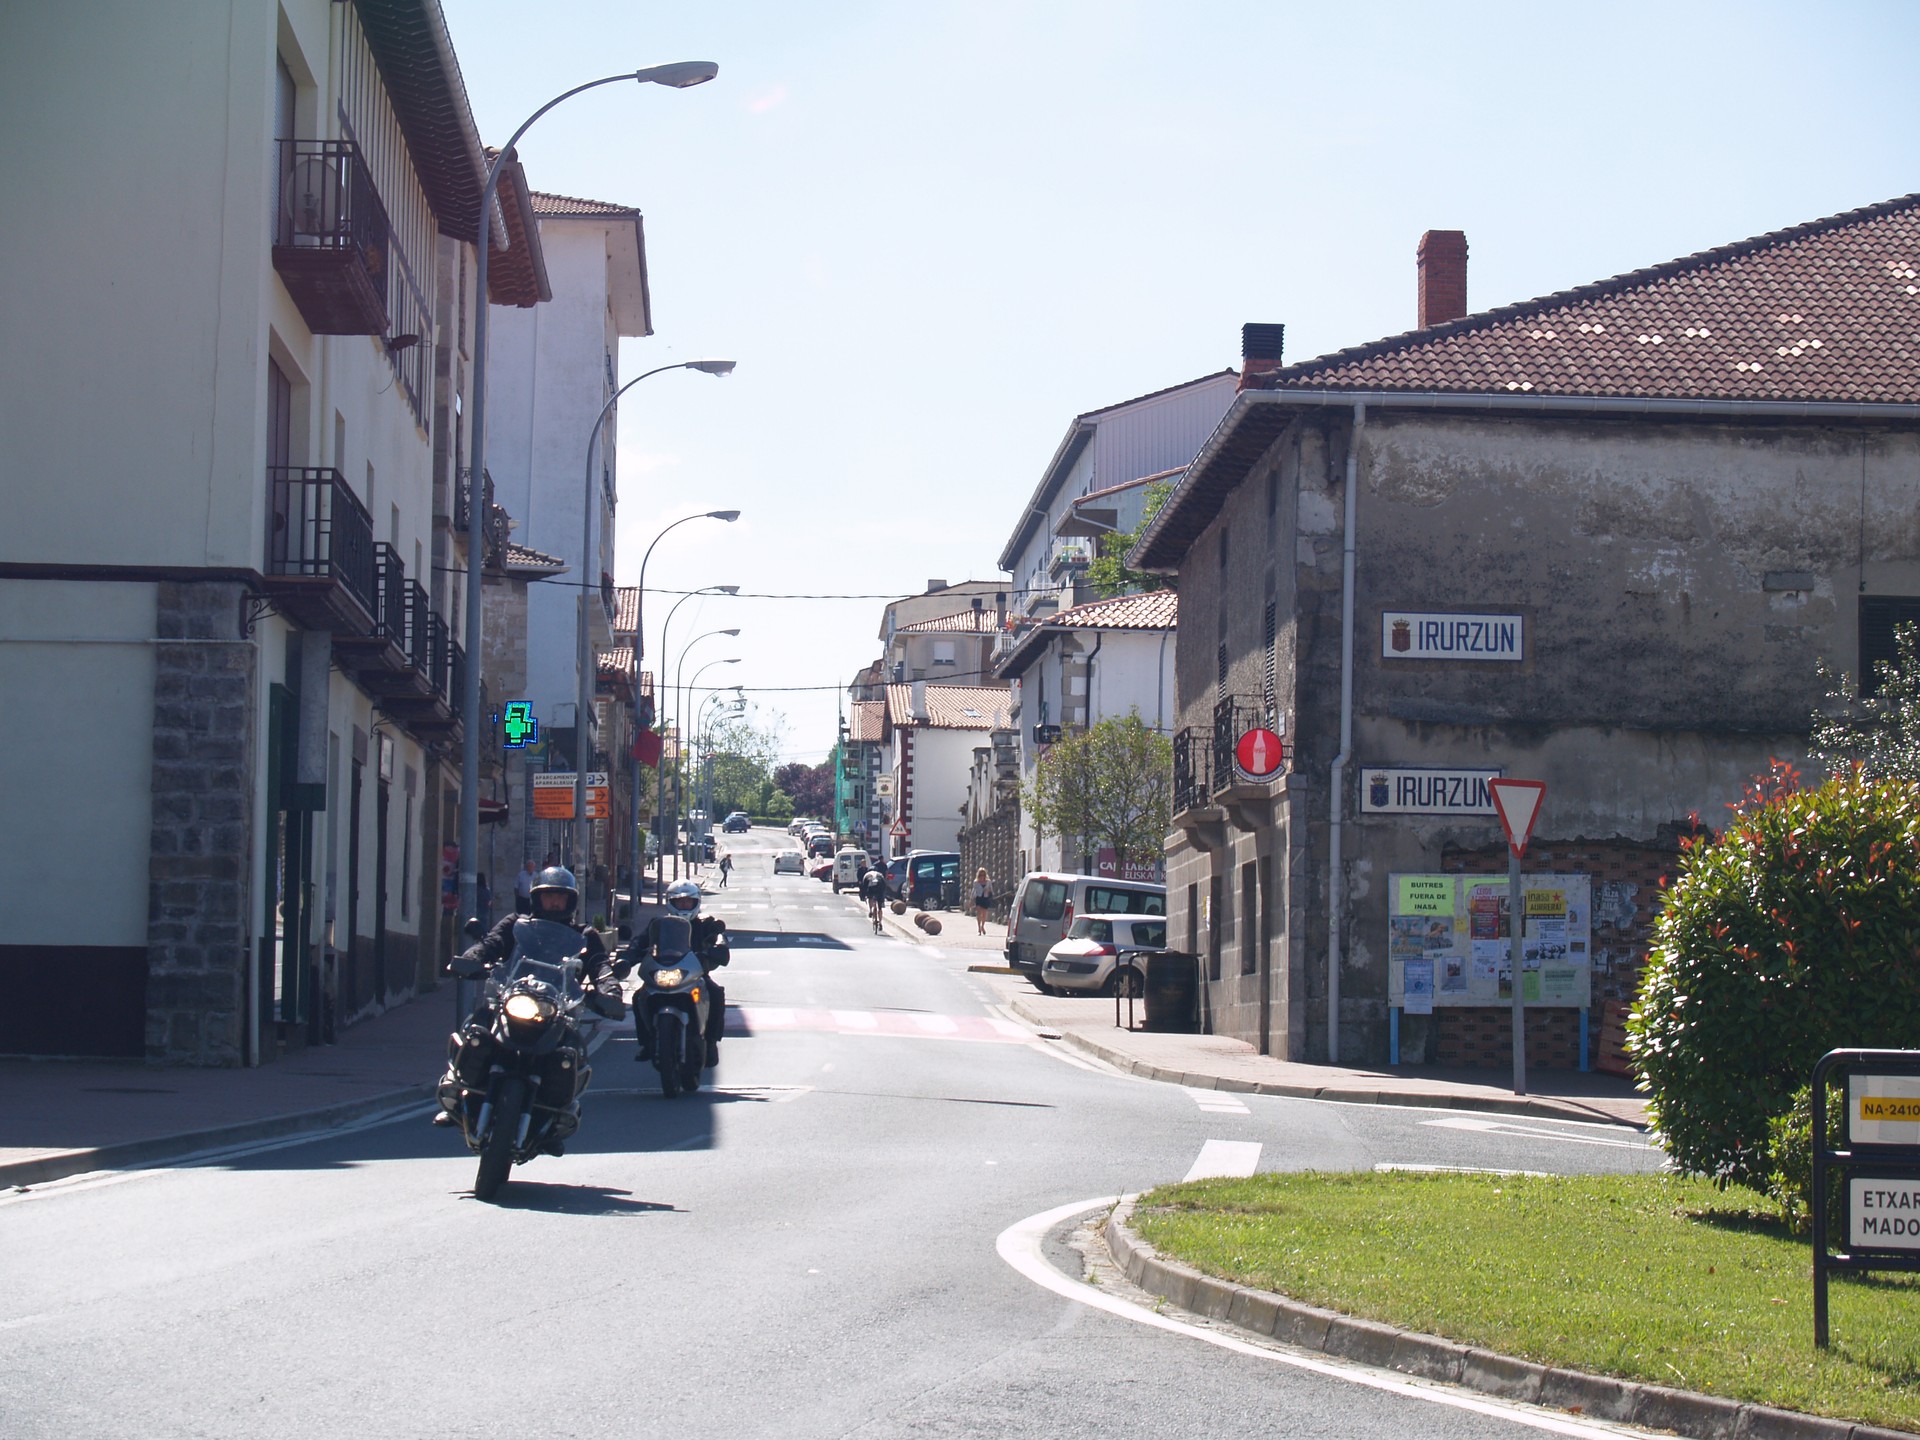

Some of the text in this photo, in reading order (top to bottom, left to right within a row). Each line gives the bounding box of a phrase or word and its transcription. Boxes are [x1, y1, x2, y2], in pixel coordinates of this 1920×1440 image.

[1418, 621, 1515, 653] IRURZUN
[1397, 776, 1493, 807] IRURZUN
[1527, 891, 1550, 902] inasa
[1864, 1103, 1920, 1116] NA-2410
